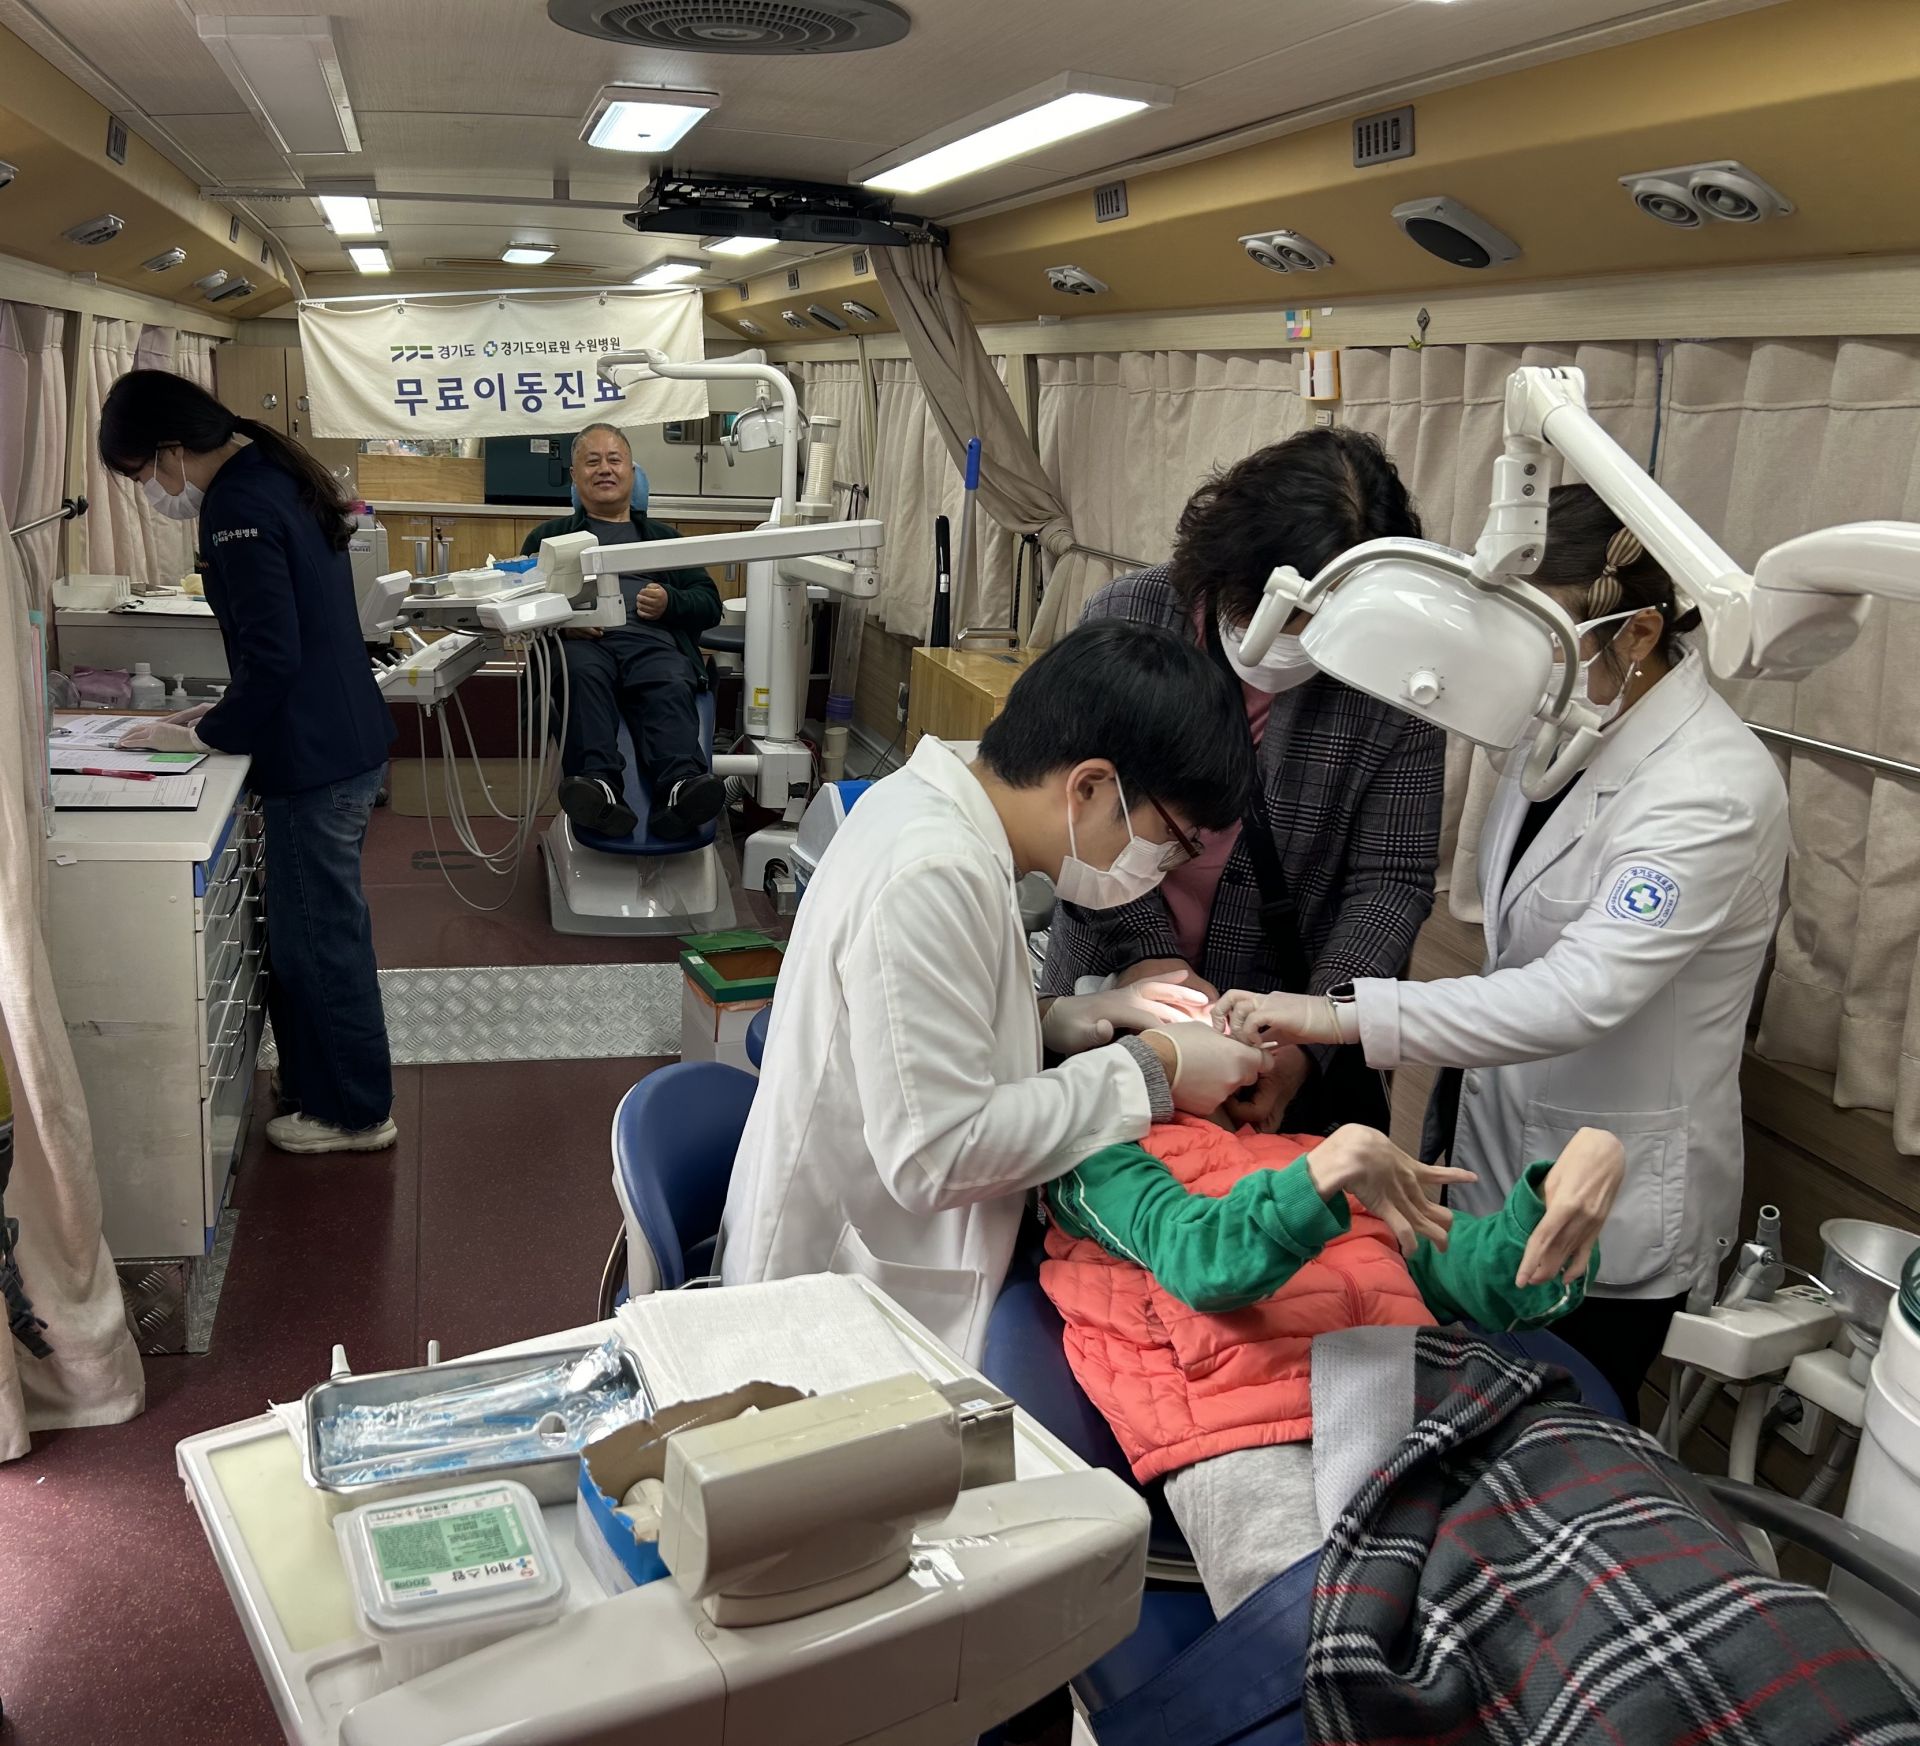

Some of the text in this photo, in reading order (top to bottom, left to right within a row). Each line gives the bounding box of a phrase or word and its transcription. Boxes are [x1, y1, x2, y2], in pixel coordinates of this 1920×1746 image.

[438, 344, 476, 360] 경기도
[500, 336, 621, 356] 경기도의료원 수원병원
[228, 528, 258, 539] 수원병원
